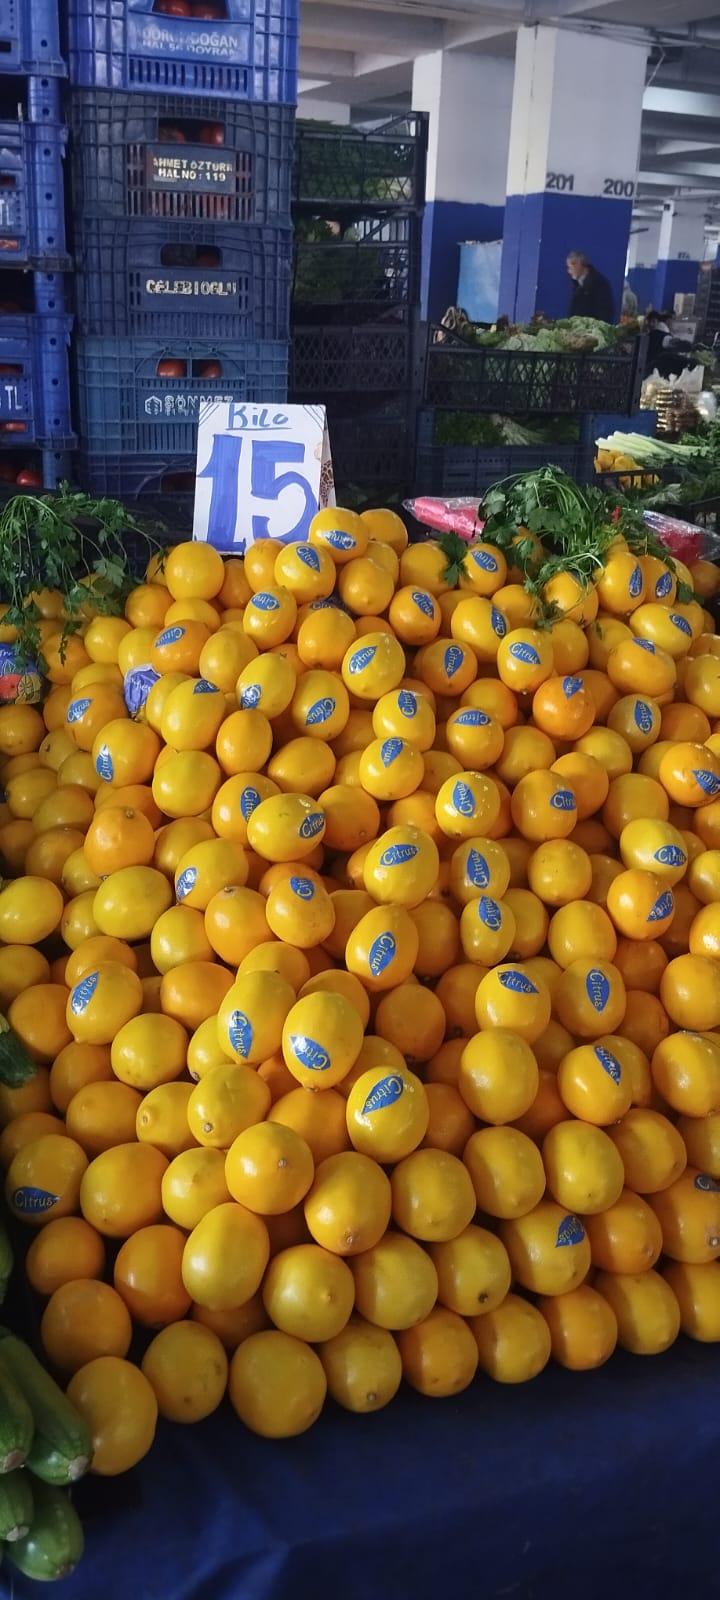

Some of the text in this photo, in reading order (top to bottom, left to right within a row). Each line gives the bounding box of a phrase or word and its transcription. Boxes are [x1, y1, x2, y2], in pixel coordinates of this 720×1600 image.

[158, 168, 180, 179] HAL
[205, 172, 226, 182] 119
[545, 173, 574, 191] 201
[603, 178, 634, 197] 200
[5, 385, 23, 411] TL
[228, 401, 289, 429] Kilo
[196, 433, 319, 553] 15
[349, 649, 375, 667] Citrus
[446, 647, 462, 673] Citrus
[510, 643, 540, 665] Citrus
[307, 699, 335, 722] Citrus
[384, 847, 416, 864] Citrus
[471, 852, 488, 886] Citrus
[371, 935, 395, 970] Citrus
[499, 973, 532, 993] Citrus
[590, 972, 606, 1008] Citrus
[232, 1014, 249, 1055] Citrus
[365, 1077, 401, 1109] Citrus
[15, 1190, 53, 1209] Citrus
